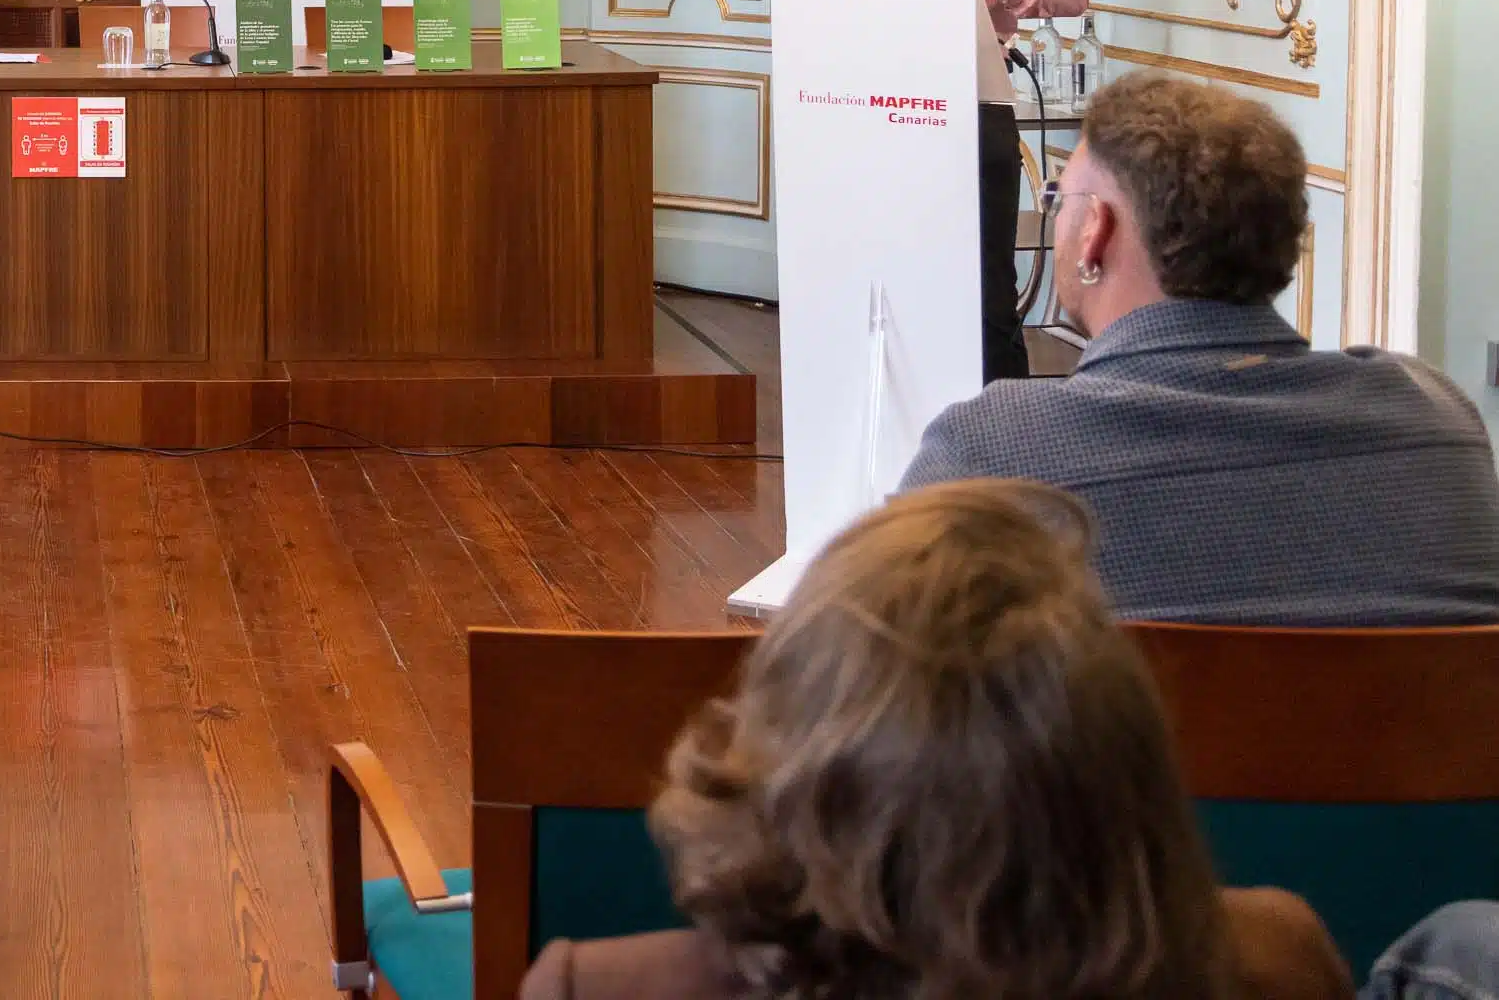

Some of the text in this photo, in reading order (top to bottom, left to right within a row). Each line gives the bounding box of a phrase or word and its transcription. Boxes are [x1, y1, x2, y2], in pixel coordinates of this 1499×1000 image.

[799, 90, 947, 111] Fundación MAPFRE
[888, 113, 947, 127] Canarias
